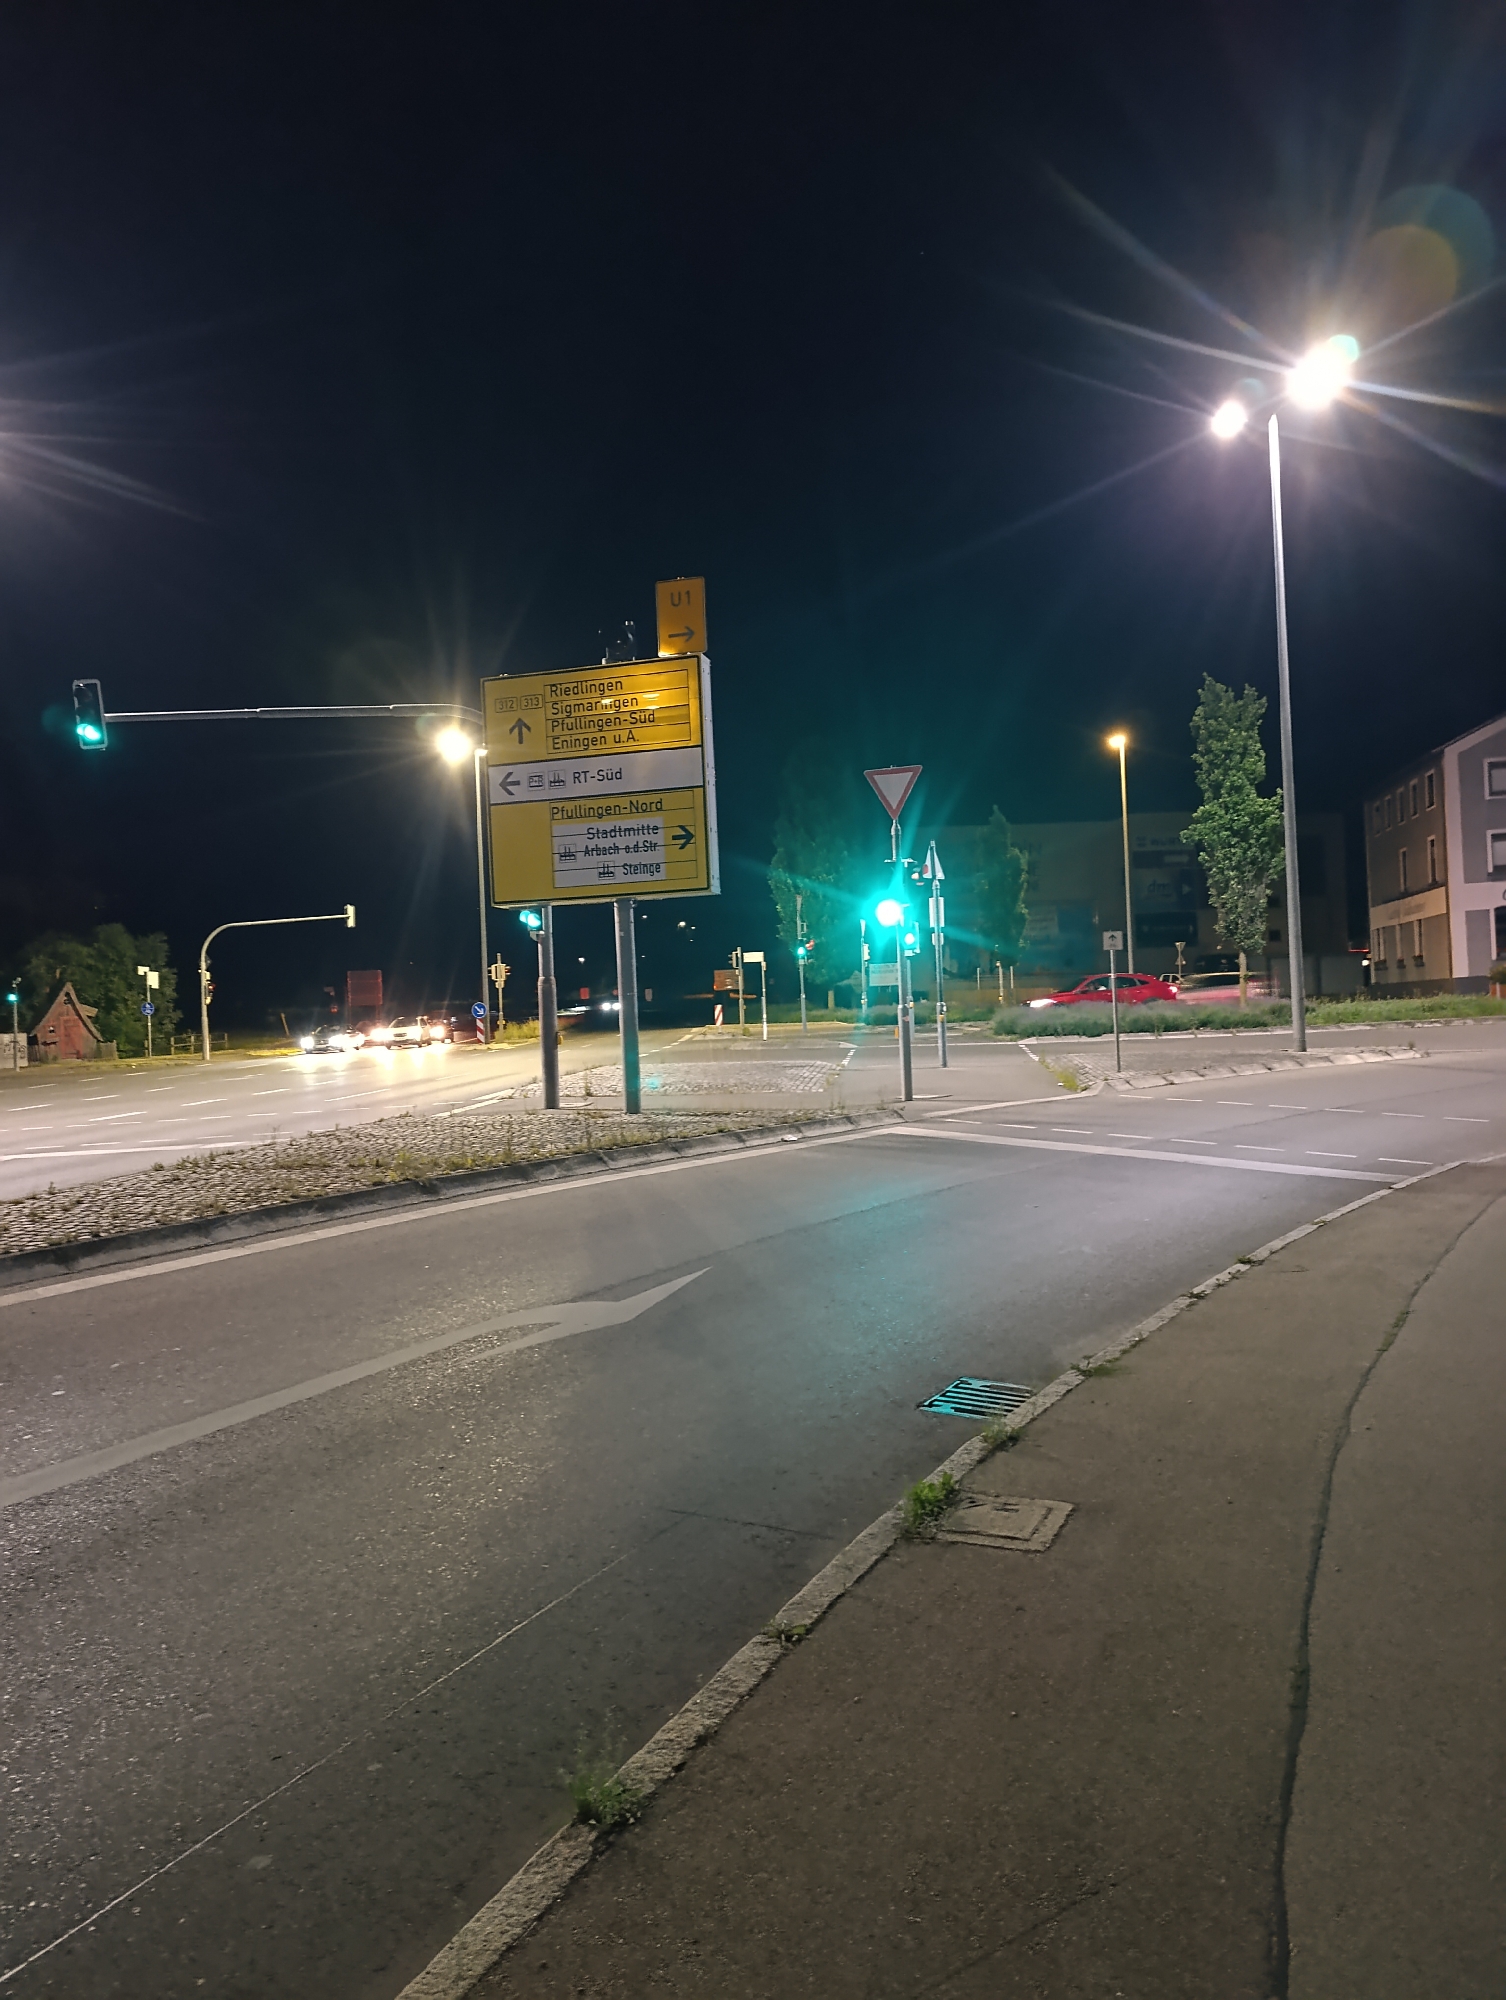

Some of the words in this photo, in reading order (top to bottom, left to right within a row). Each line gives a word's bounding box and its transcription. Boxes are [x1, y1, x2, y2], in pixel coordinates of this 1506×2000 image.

[670, 591, 691, 607] U1
[550, 678, 623, 697] Riedlingen
[498, 699, 515, 710] 312
[523, 697, 540, 707] 313
[551, 696, 638, 715] Sigmaringen
[551, 711, 655, 732] Pfullingen-Süd
[552, 734, 607, 750] Eningen
[614, 731, 640, 744] u.A.
[573, 768, 622, 783] RT-Süd
[552, 798, 663, 820] Pfullingen-Nord
[586, 823, 659, 839] Stadtmitte
[584, 844, 620, 857] Arbach
